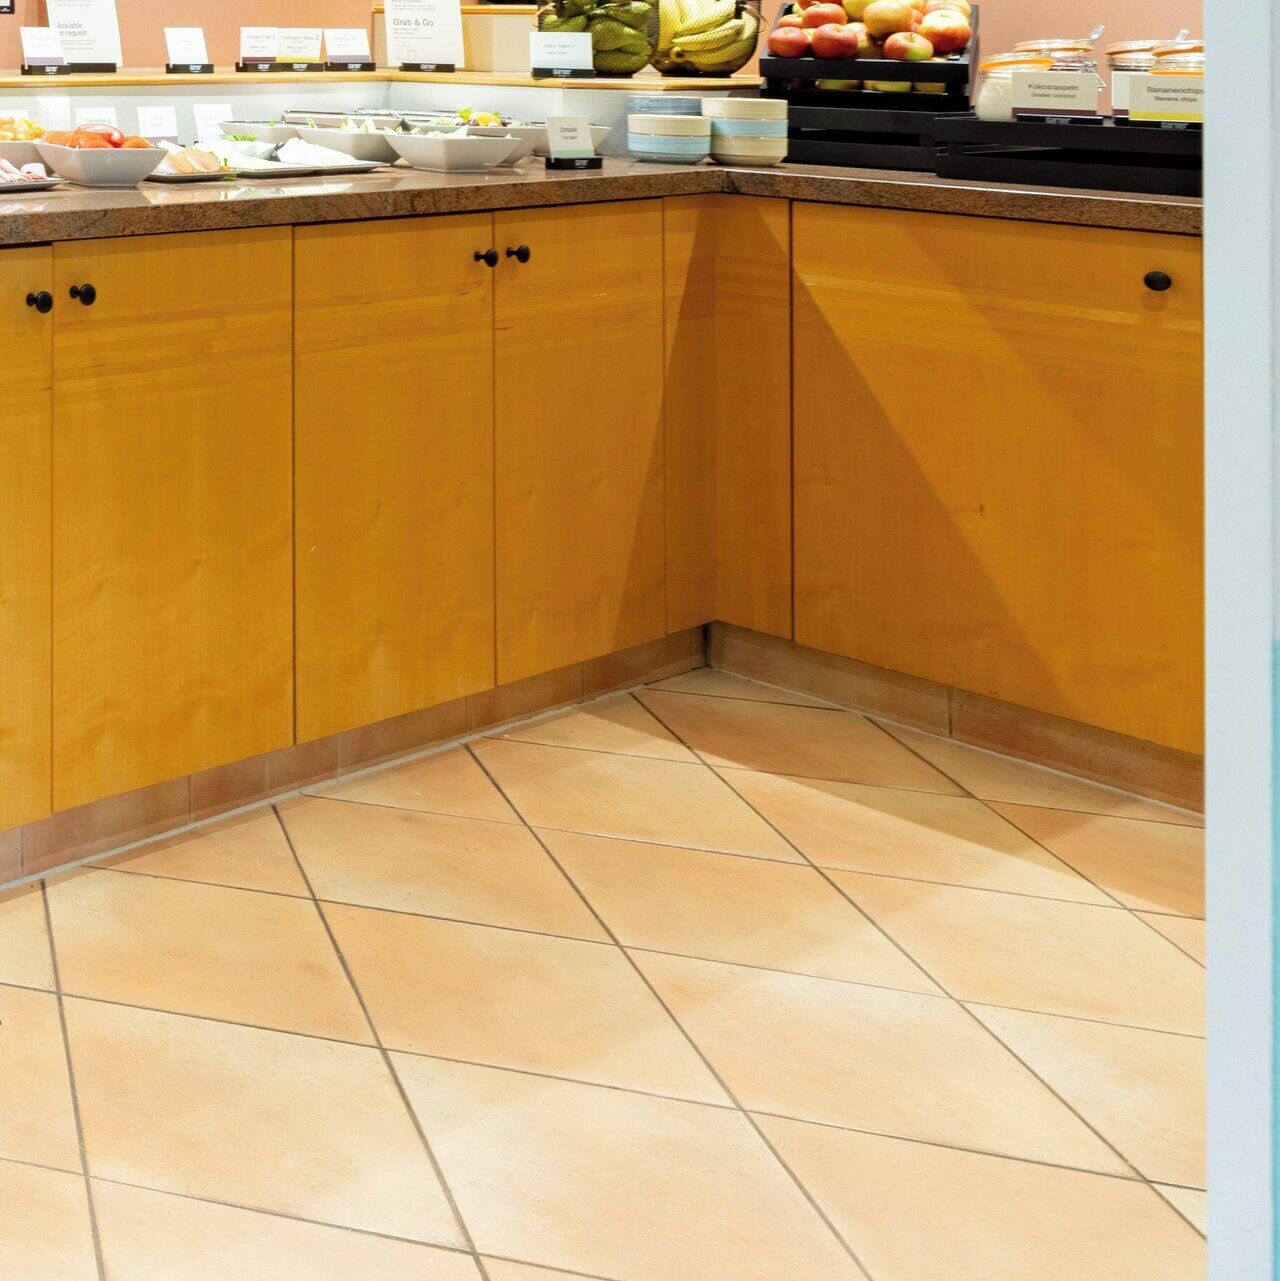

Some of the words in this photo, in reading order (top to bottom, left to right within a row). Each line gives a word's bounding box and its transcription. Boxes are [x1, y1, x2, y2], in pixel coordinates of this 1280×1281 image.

[392, 18, 412, 26] Grab
[414, 18, 420, 26] &
[422, 18, 434, 27] Go
